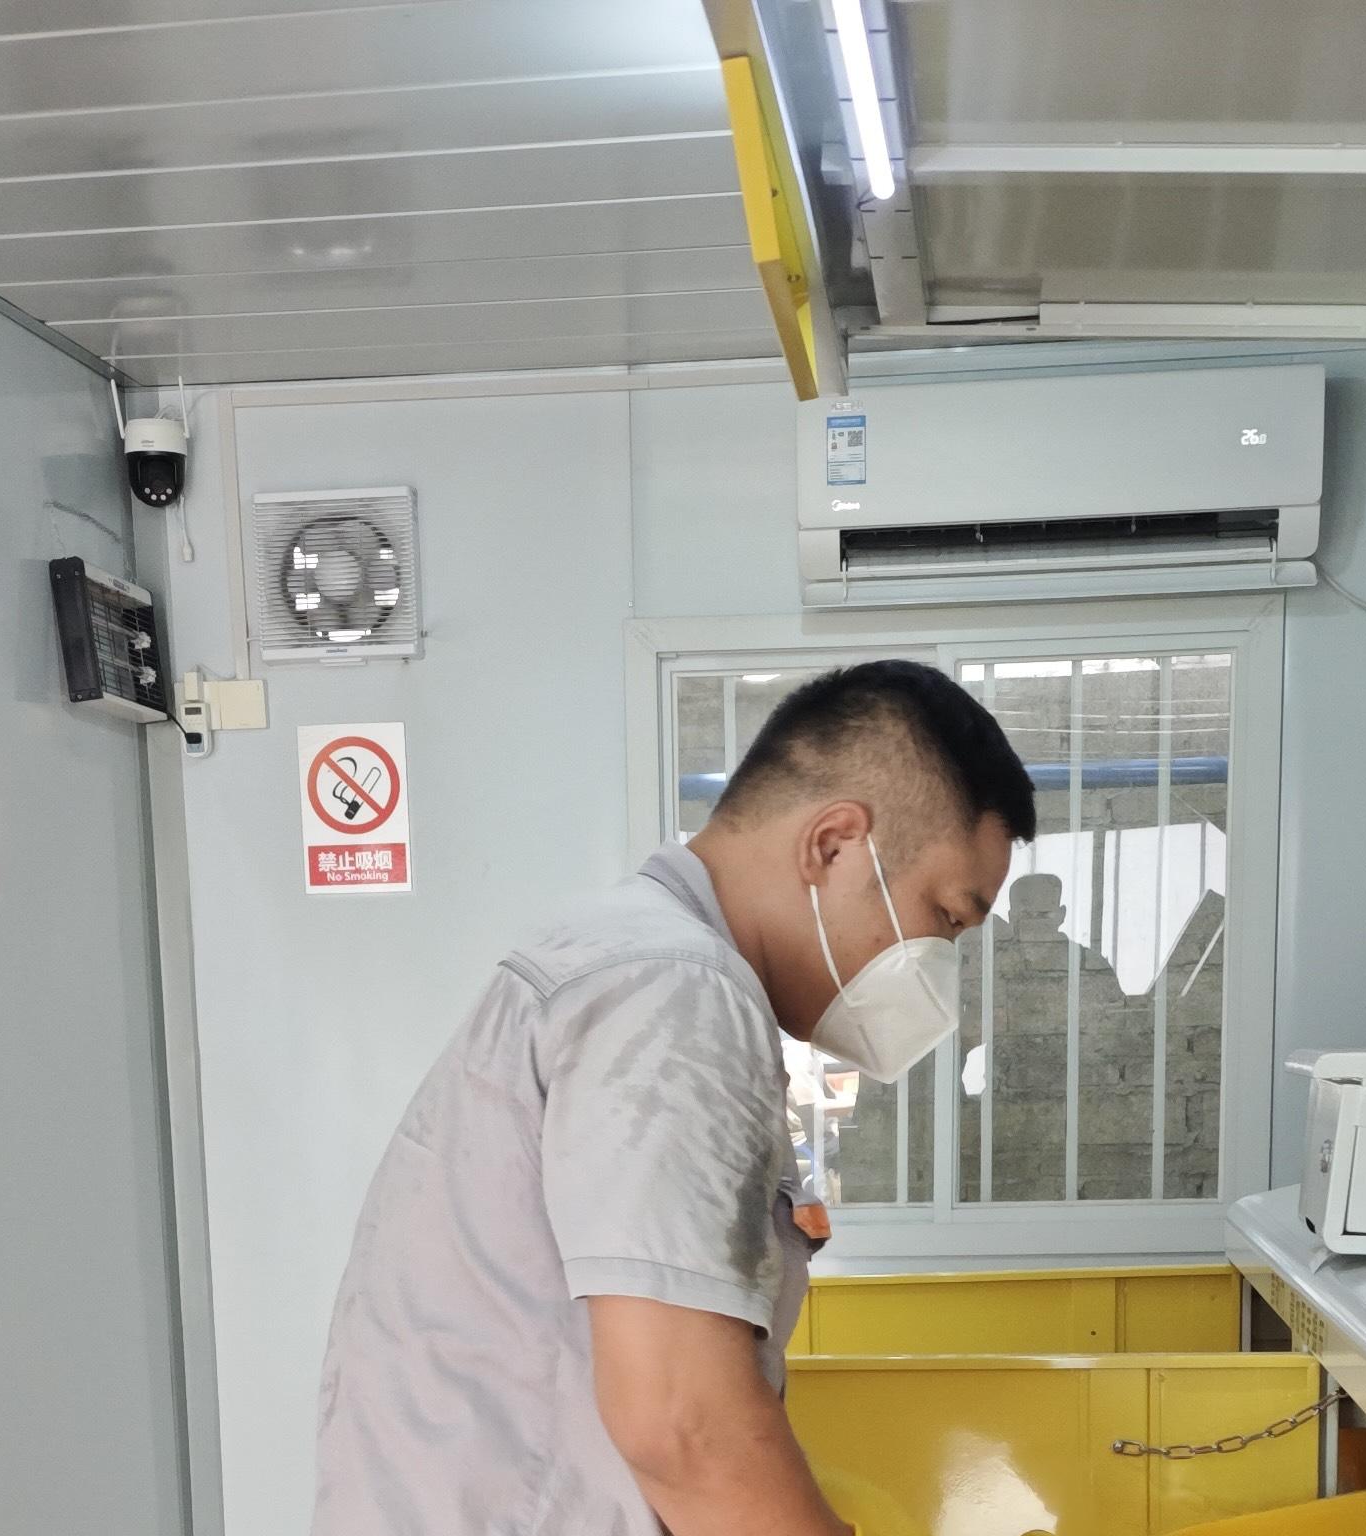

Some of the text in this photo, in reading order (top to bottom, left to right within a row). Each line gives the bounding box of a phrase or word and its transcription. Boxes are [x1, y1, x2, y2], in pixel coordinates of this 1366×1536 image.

[318, 850, 392, 872] 禁止吸烟
[328, 871, 389, 883] No Smoking
